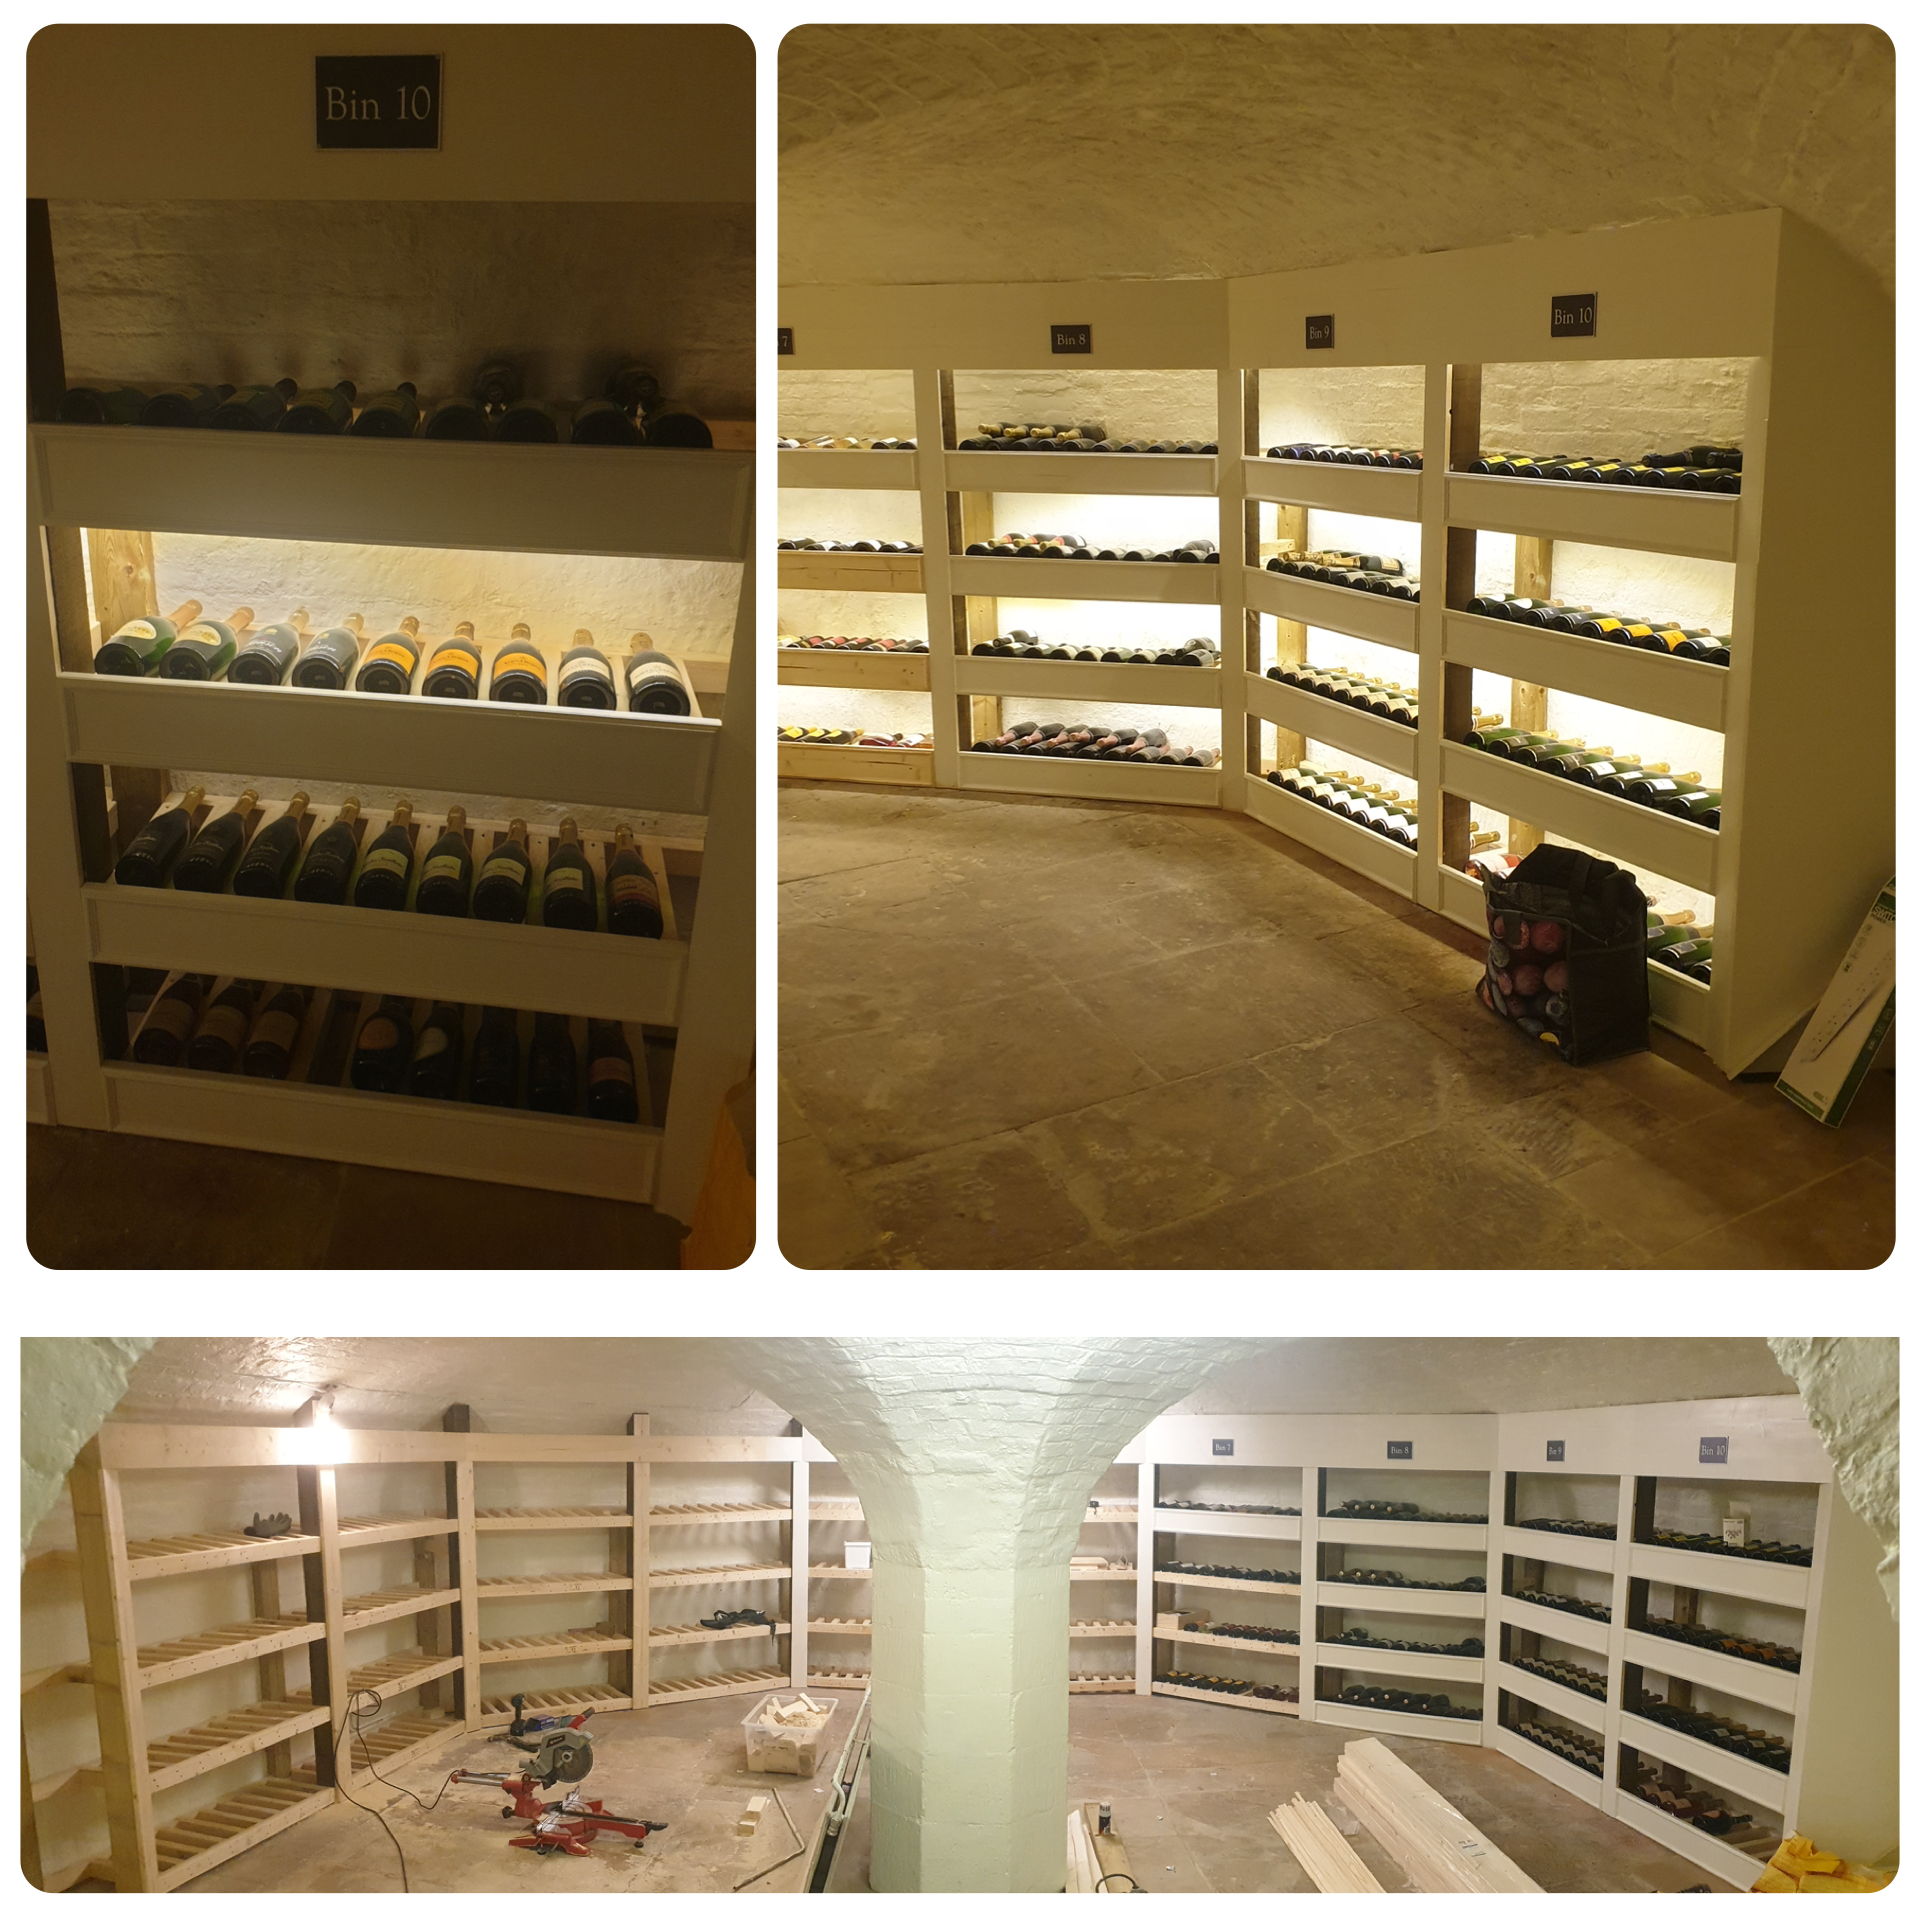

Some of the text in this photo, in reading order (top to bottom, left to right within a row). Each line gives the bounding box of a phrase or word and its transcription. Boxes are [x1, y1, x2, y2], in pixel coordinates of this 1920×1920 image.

[324, 85, 431, 121] Bin 10
[1554, 306, 1593, 325] Bin 10
[1309, 324, 1330, 340] Bin 9
[782, 335, 788, 347] 7
[1056, 333, 1086, 346] Bin 8
[1215, 1443, 1227, 1452] Bin
[1390, 1446, 1410, 1455] Bin 8
[1548, 1446, 1563, 1456] Bin 9
[1701, 1445, 1726, 1456] Bin 10
